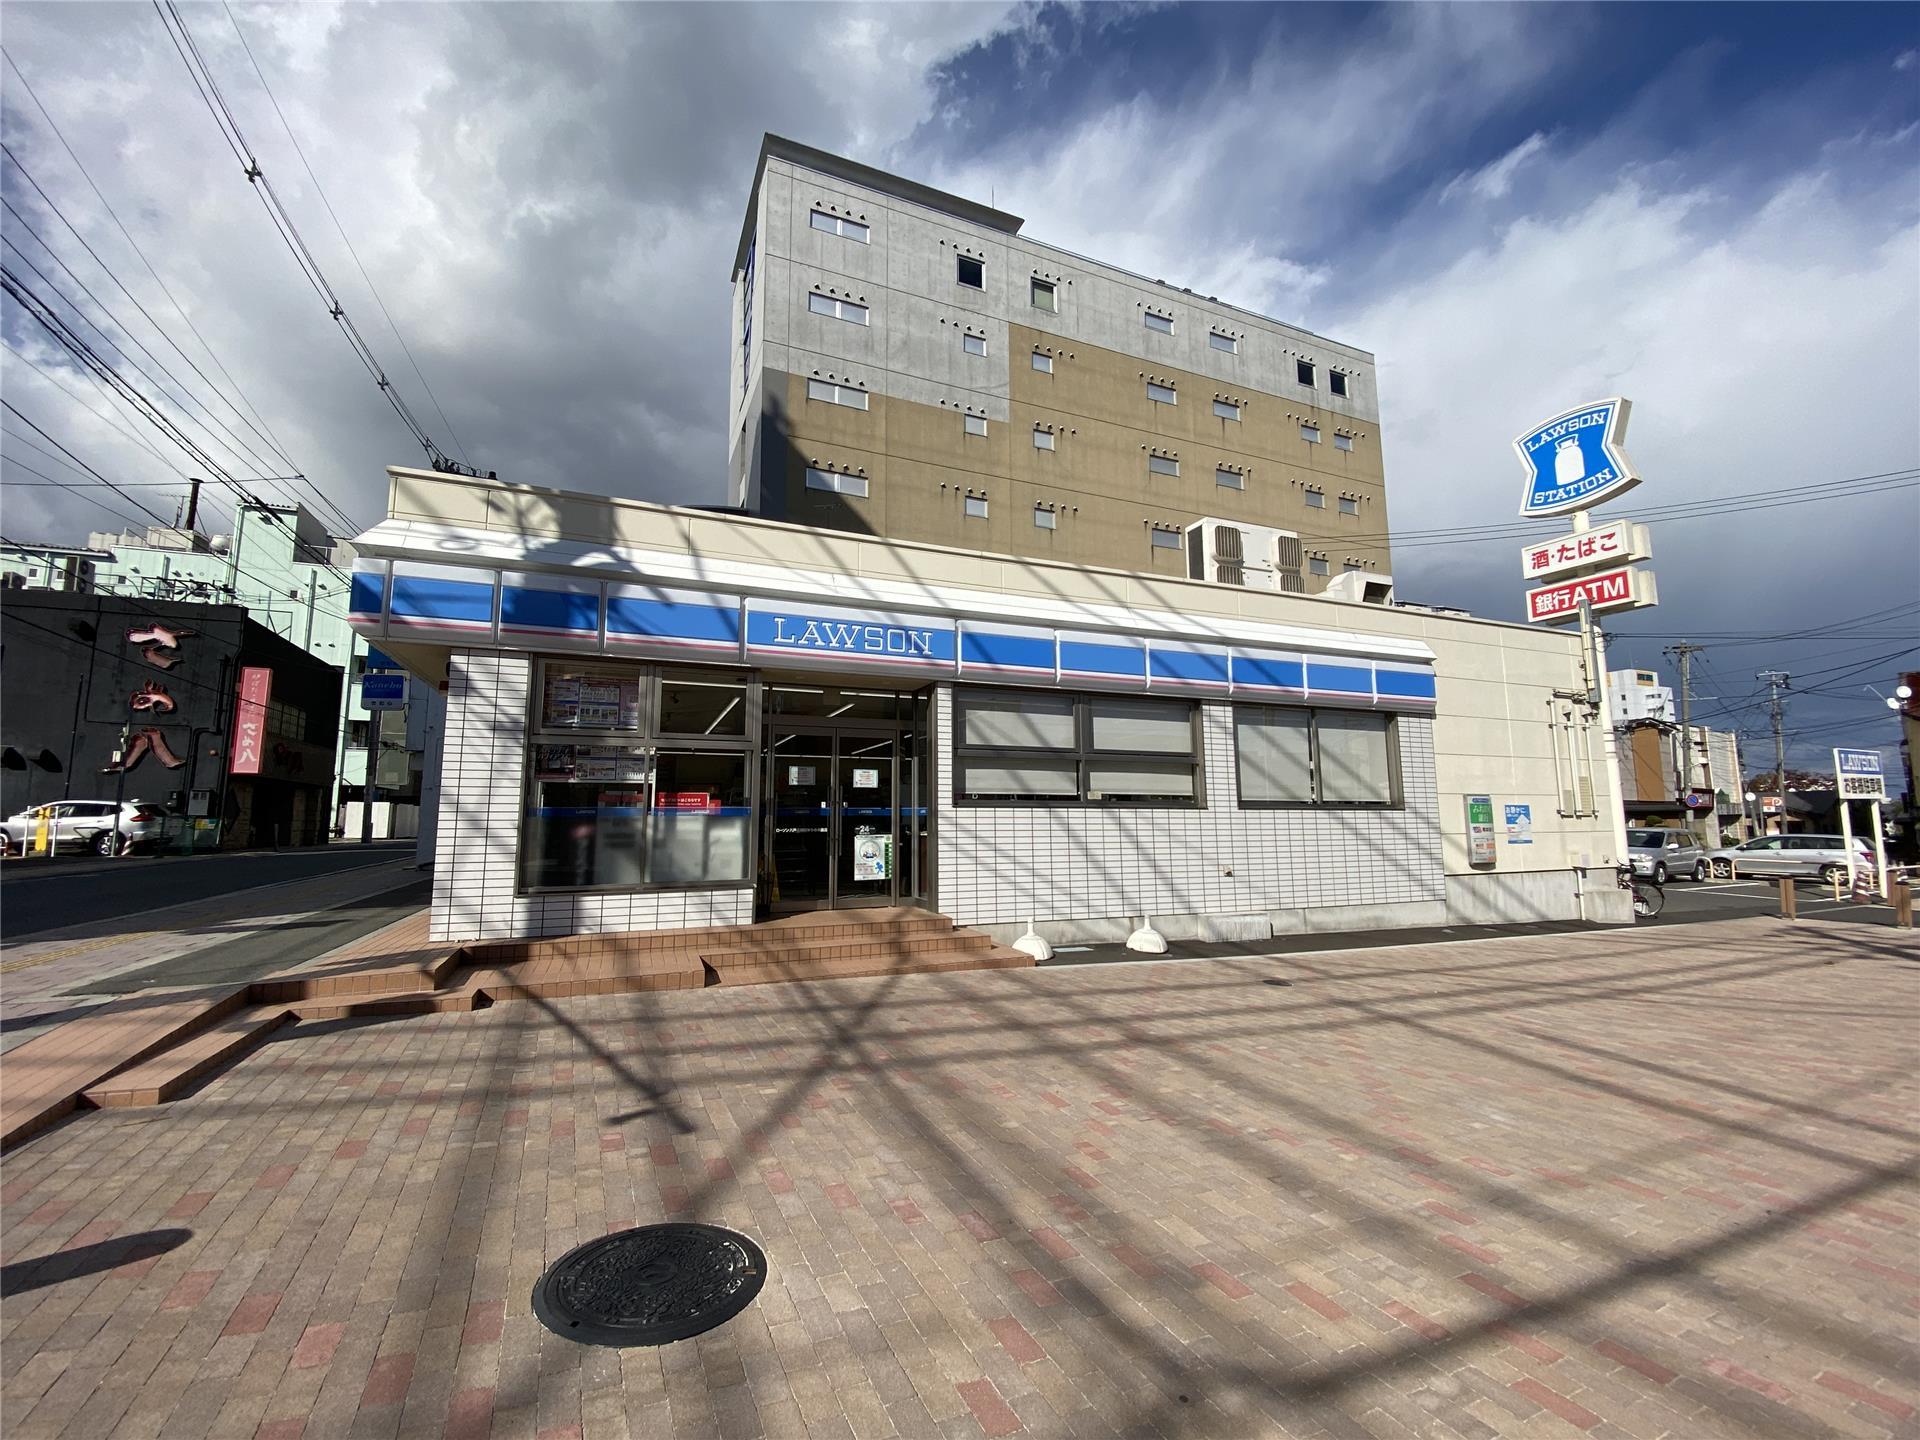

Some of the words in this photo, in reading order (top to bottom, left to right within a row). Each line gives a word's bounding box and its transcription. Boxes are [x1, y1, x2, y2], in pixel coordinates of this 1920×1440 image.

[1526, 412, 1606, 452] LAWSON
[1534, 468, 1613, 504] STATION
[1535, 576, 1625, 613] 銀行ATM
[774, 617, 932, 655] LAWSON
[1841, 754, 1879, 771] LAWSON
